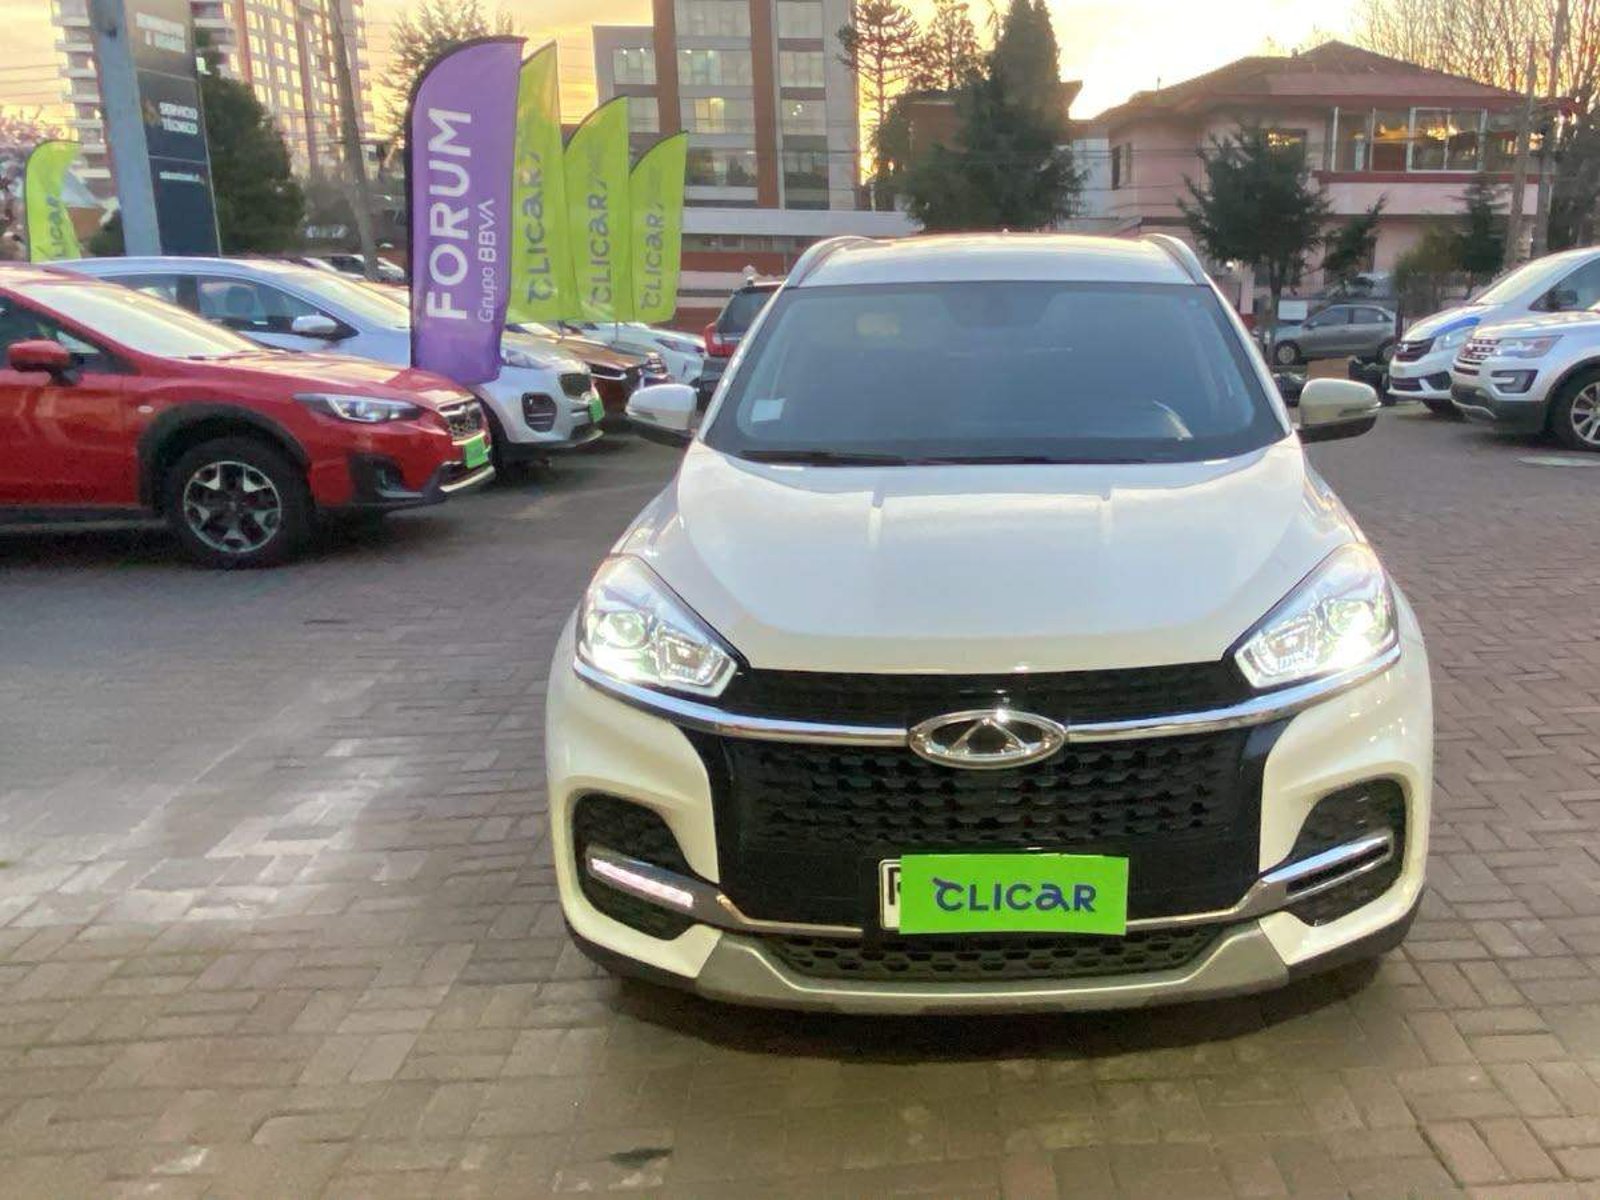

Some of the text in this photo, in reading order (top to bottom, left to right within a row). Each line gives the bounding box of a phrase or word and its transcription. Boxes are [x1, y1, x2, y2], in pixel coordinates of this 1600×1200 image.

[427, 107, 473, 319] FORUM
[476, 198, 500, 322] Grupo BBVA
